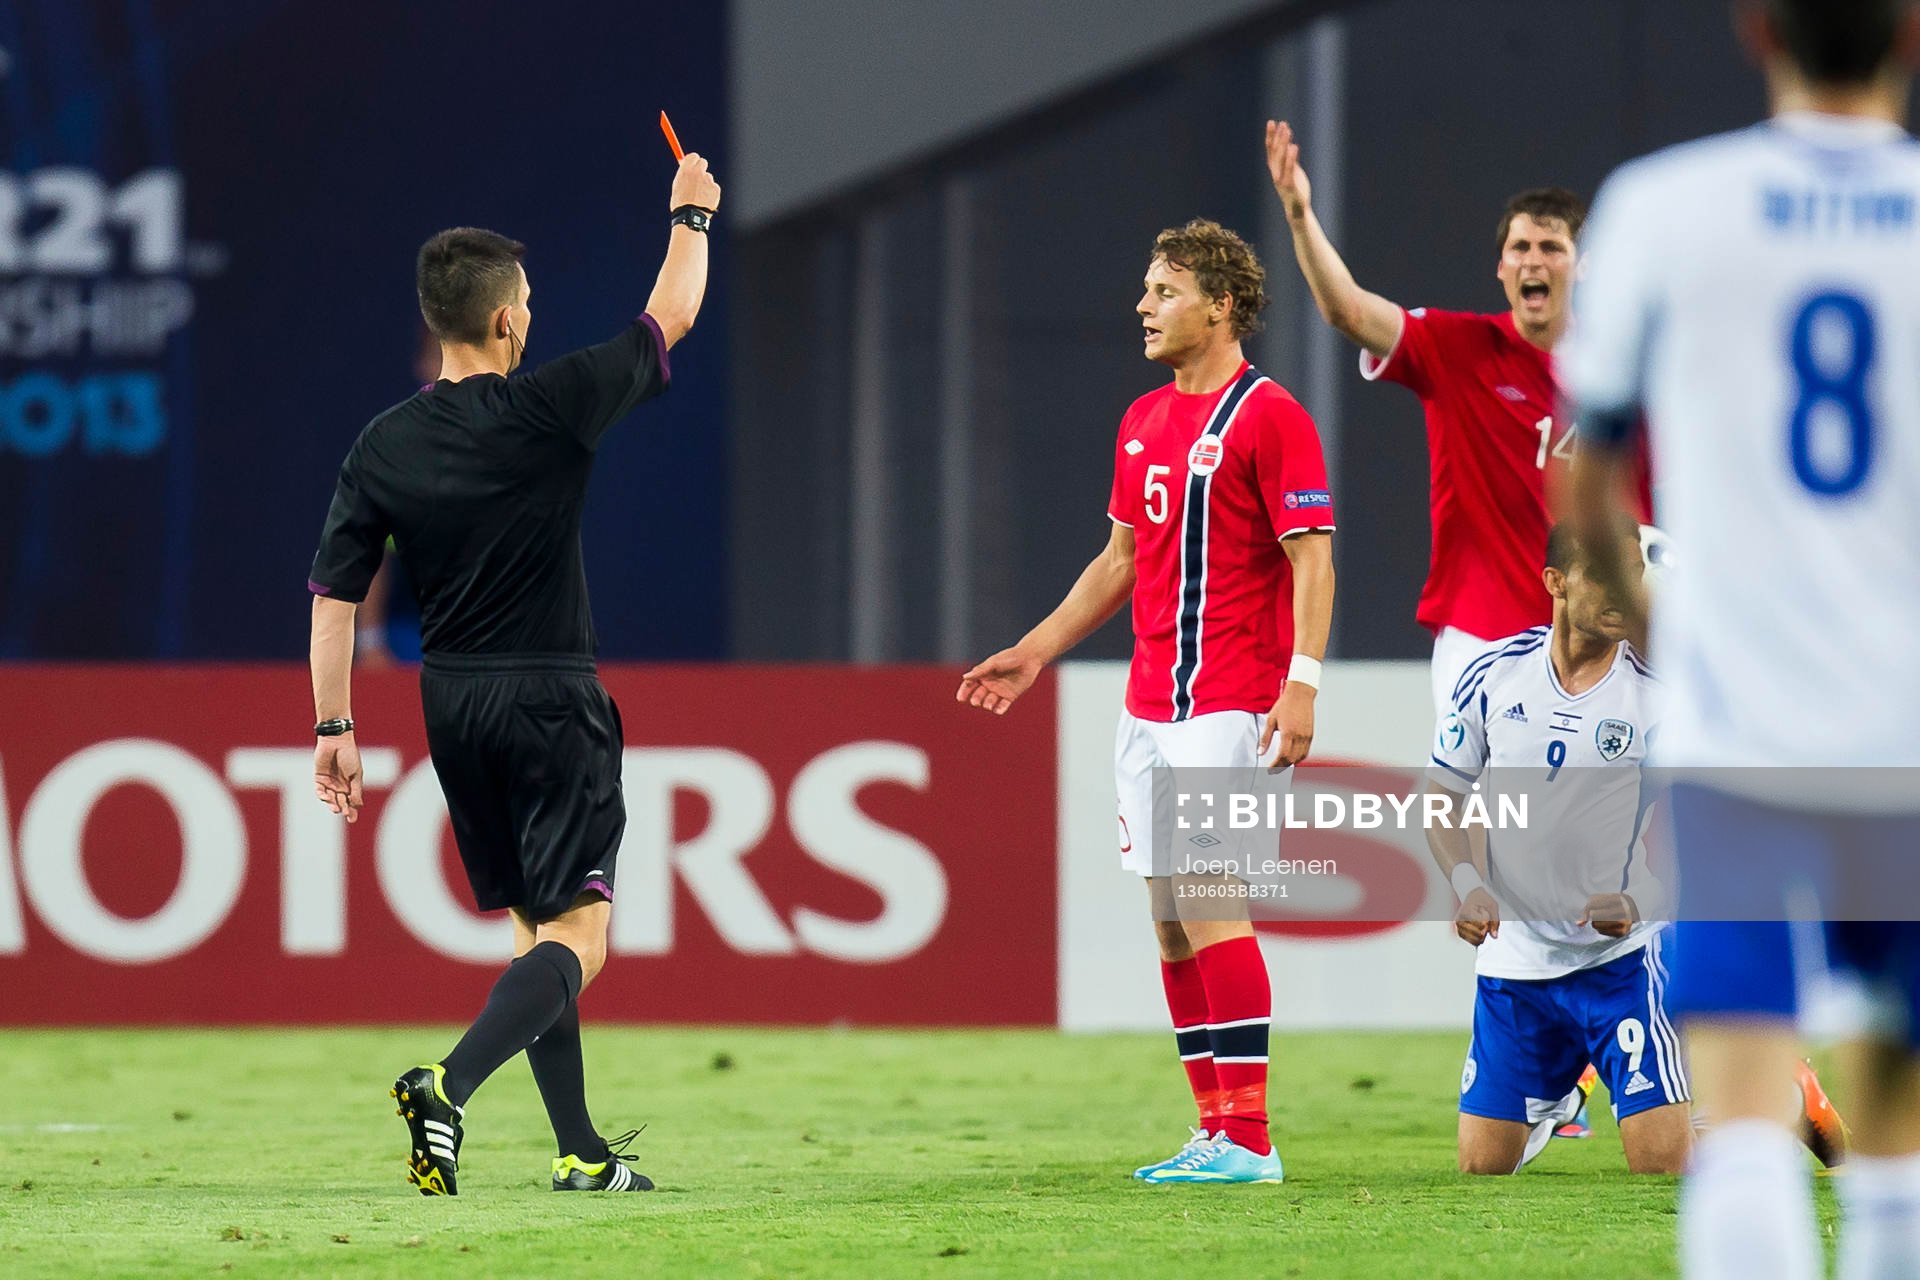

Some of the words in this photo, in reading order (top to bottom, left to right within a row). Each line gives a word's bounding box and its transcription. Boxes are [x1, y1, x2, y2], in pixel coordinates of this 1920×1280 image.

[0, 278, 194, 355] SHIP
[0, 373, 166, 454] 013
[1786, 288, 1876, 500] 8
[1535, 416, 1580, 471] 14
[1144, 464, 1170, 524] 5
[1546, 740, 1566, 782] 9
[0, 738, 949, 964] OTRS
[1617, 1017, 1645, 1072] 9
